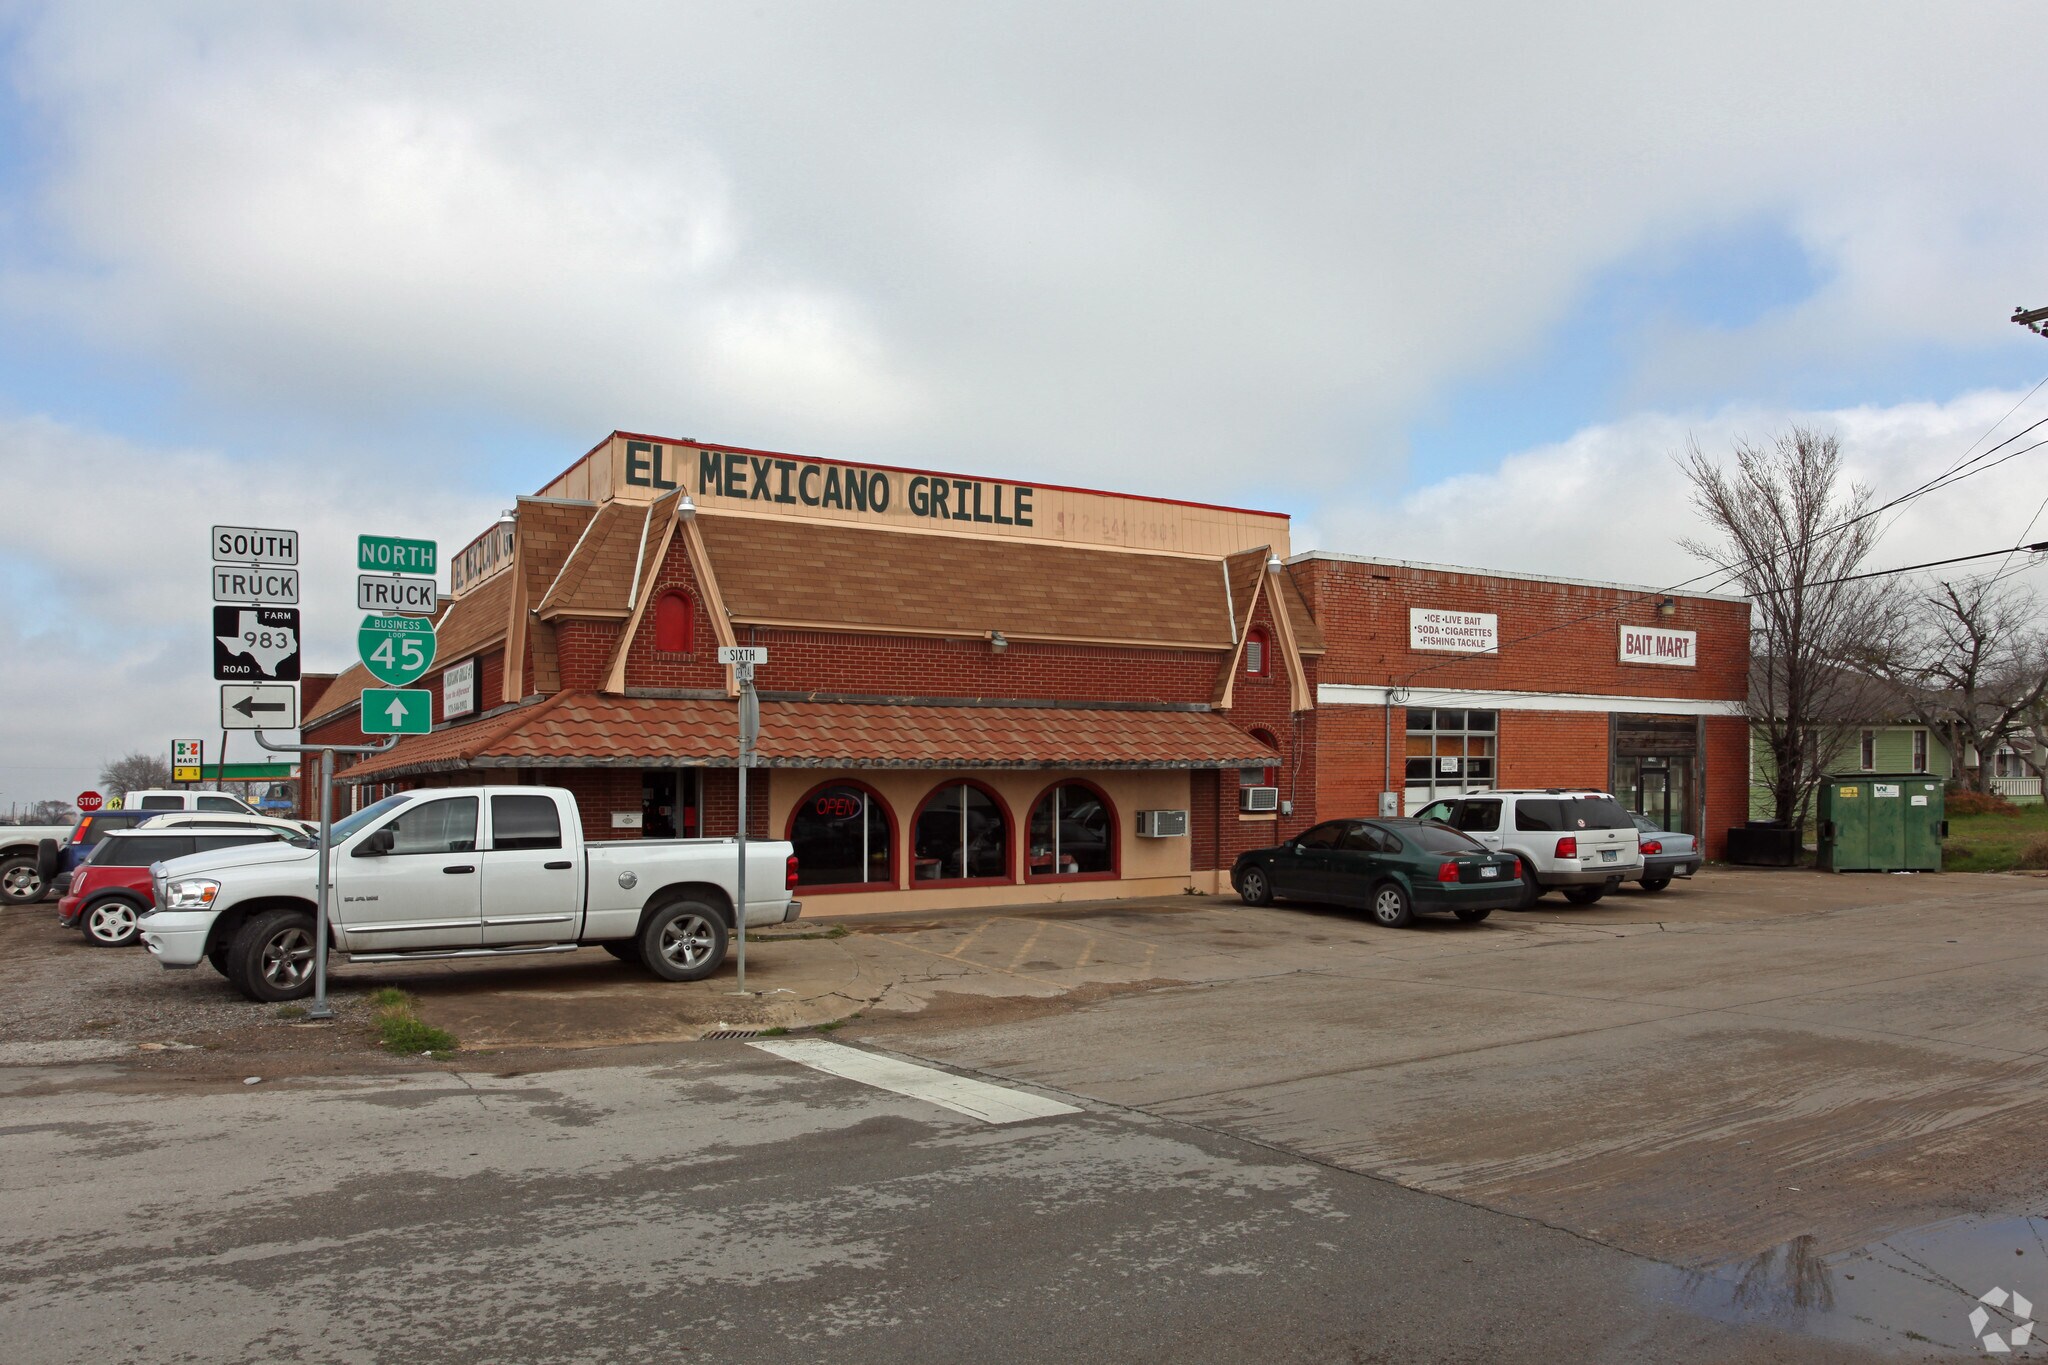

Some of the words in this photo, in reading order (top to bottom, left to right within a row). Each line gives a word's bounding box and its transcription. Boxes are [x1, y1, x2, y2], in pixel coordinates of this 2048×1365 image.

[626, 440, 677, 491] EL
[699, 450, 890, 513] MEXICANO
[908, 475, 1034, 527] GRILLE
[219, 534, 293, 558] SOUTH
[362, 543, 434, 568] NORTH
[218, 573, 294, 597] TRUCK
[362, 583, 432, 606] TRUCK
[264, 611, 291, 620] FARM
[374, 619, 421, 630] BUSINESS
[1464, 616, 1482, 626] BAIT
[243, 631, 288, 649] 983
[1457, 638, 1486, 648] TACKLE
[1626, 633, 1653, 656] BAIT
[1656, 635, 1689, 658] MART
[369, 637, 424, 671] 45
[729, 649, 756, 662] SIXTH
[223, 665, 250, 674] ROAD
[177, 742, 199, 755] E-Z
[78, 797, 102, 806] STOP
[816, 797, 857, 816] OPEN
